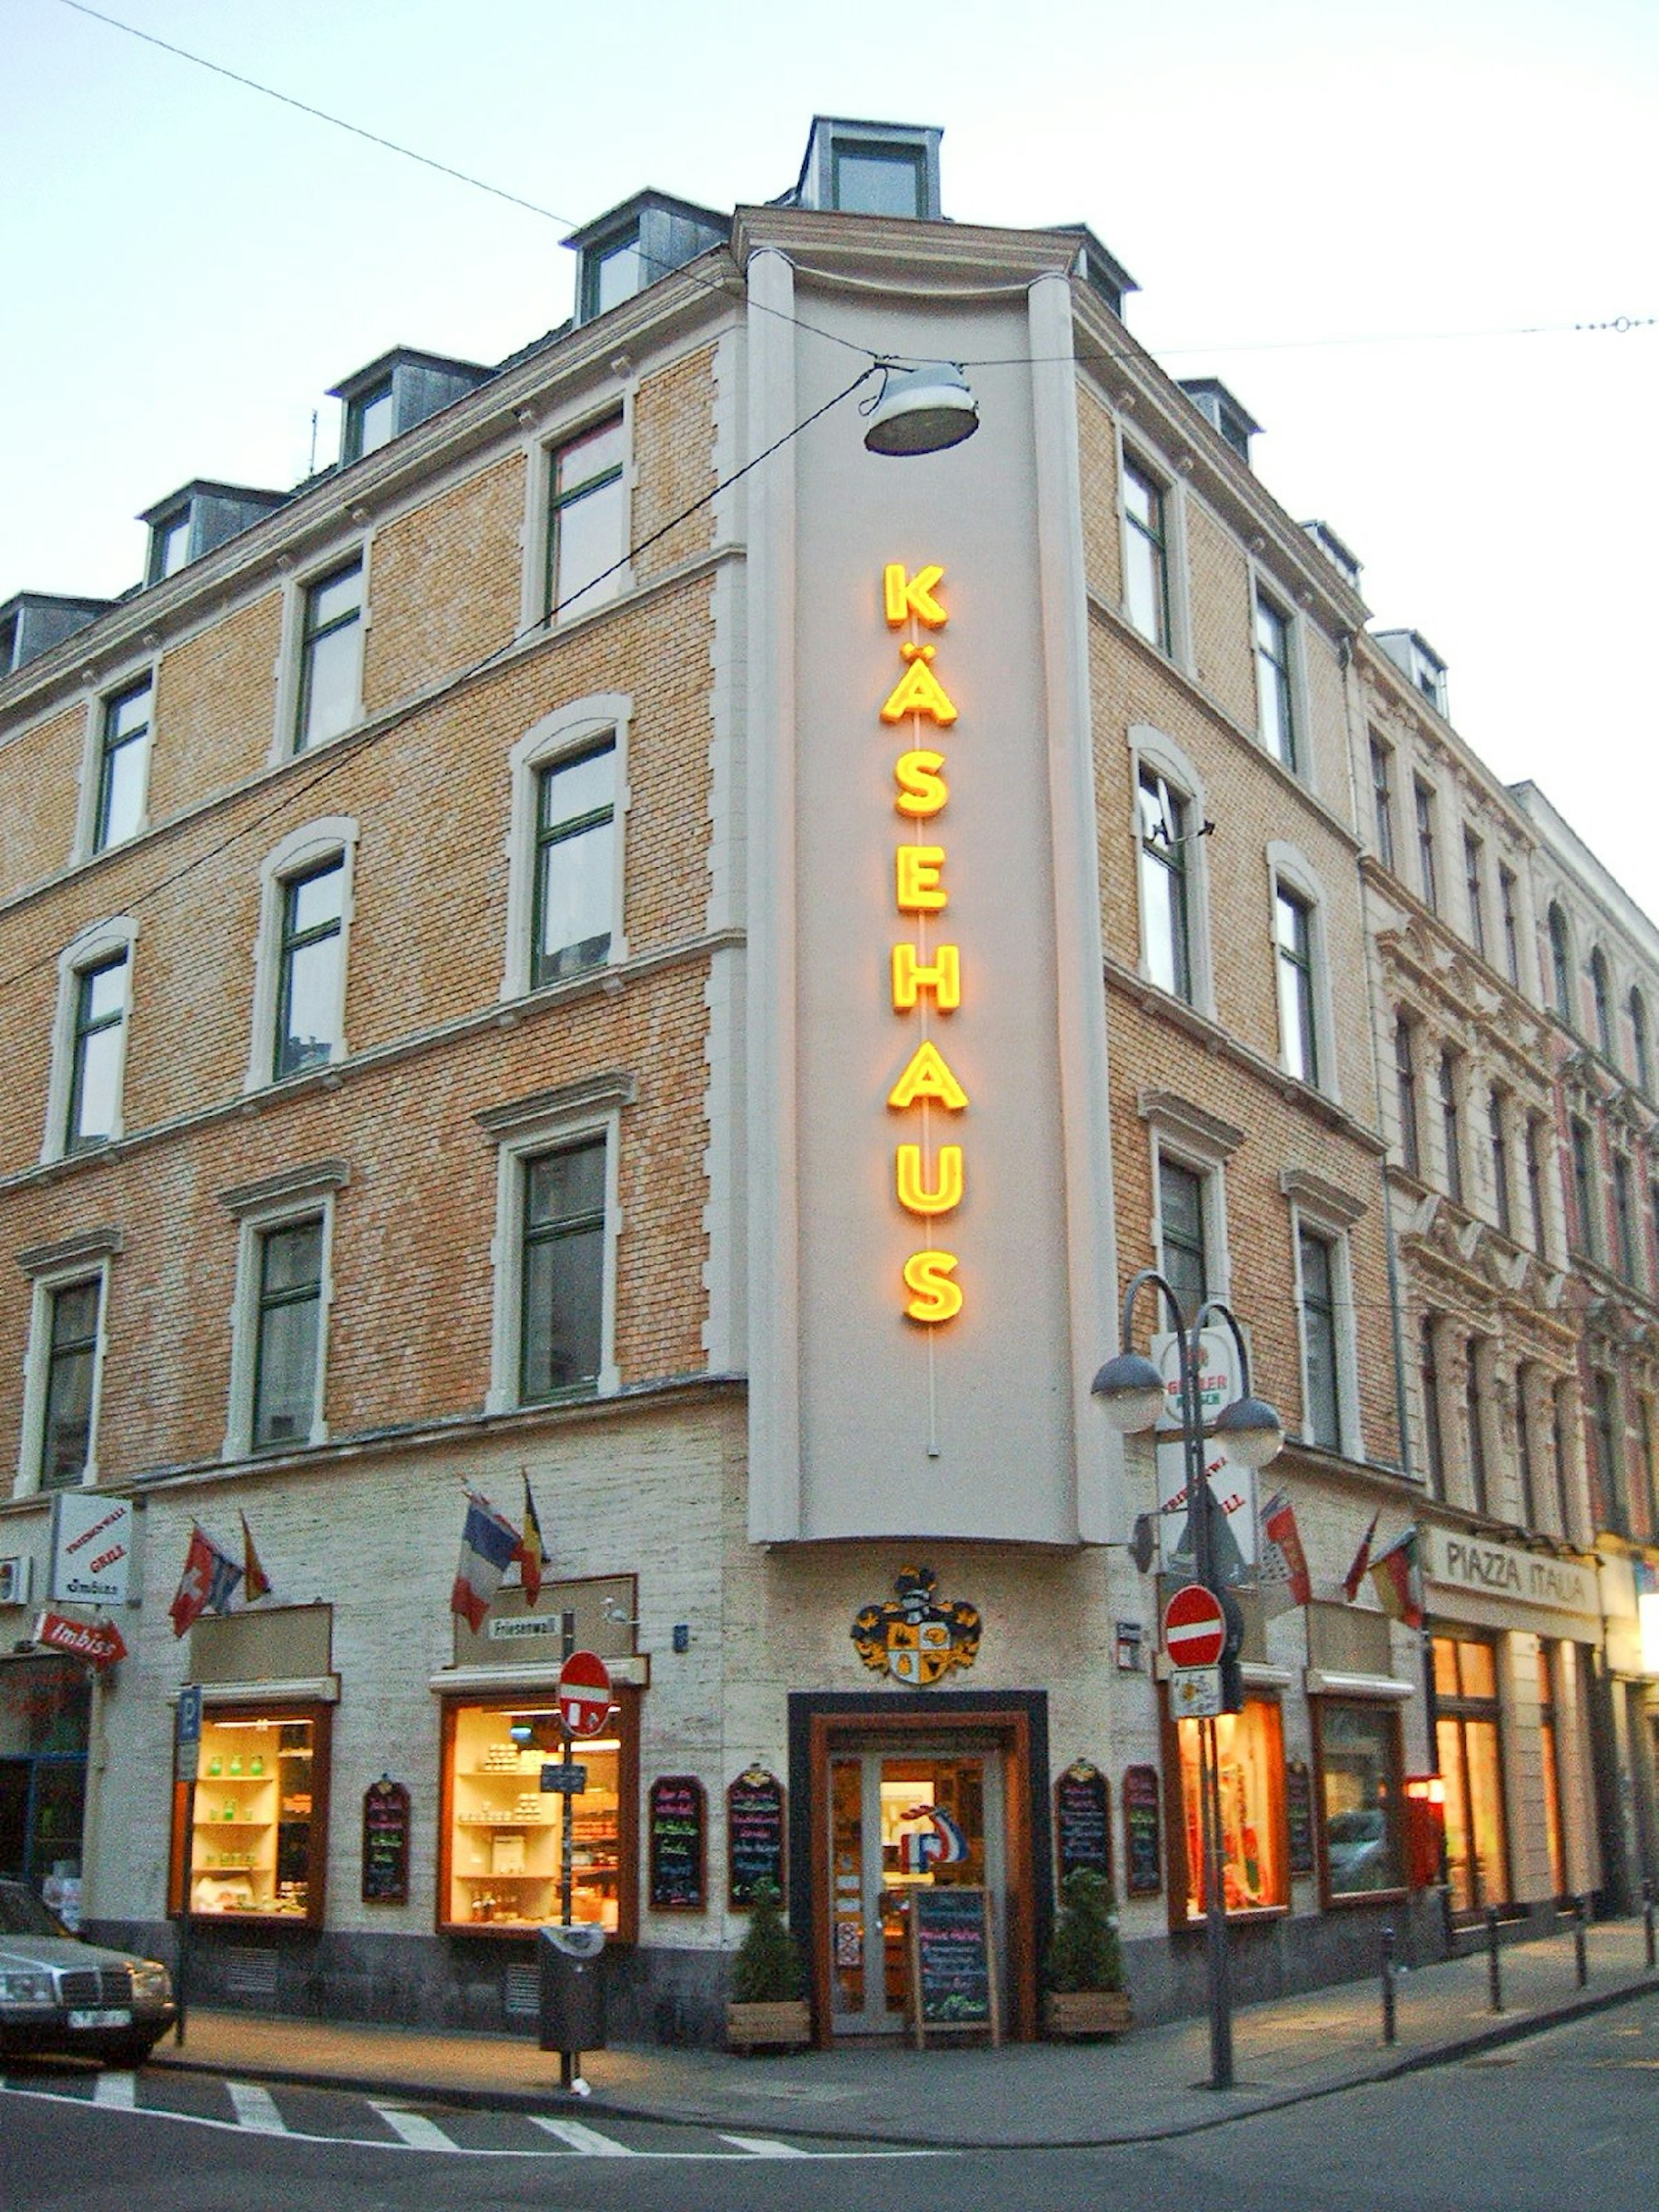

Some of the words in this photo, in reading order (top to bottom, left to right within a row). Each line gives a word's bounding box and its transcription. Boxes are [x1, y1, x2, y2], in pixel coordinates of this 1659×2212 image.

[881, 564, 969, 1323] KÄSEHAUS
[90, 1543, 127, 1574] GRILL
[1446, 1541, 1521, 1591] PIAZZA
[1529, 1563, 1585, 1603] ITALIA
[51, 1621, 117, 1656] Imbiss
[494, 1617, 556, 1637] Friesenwall
